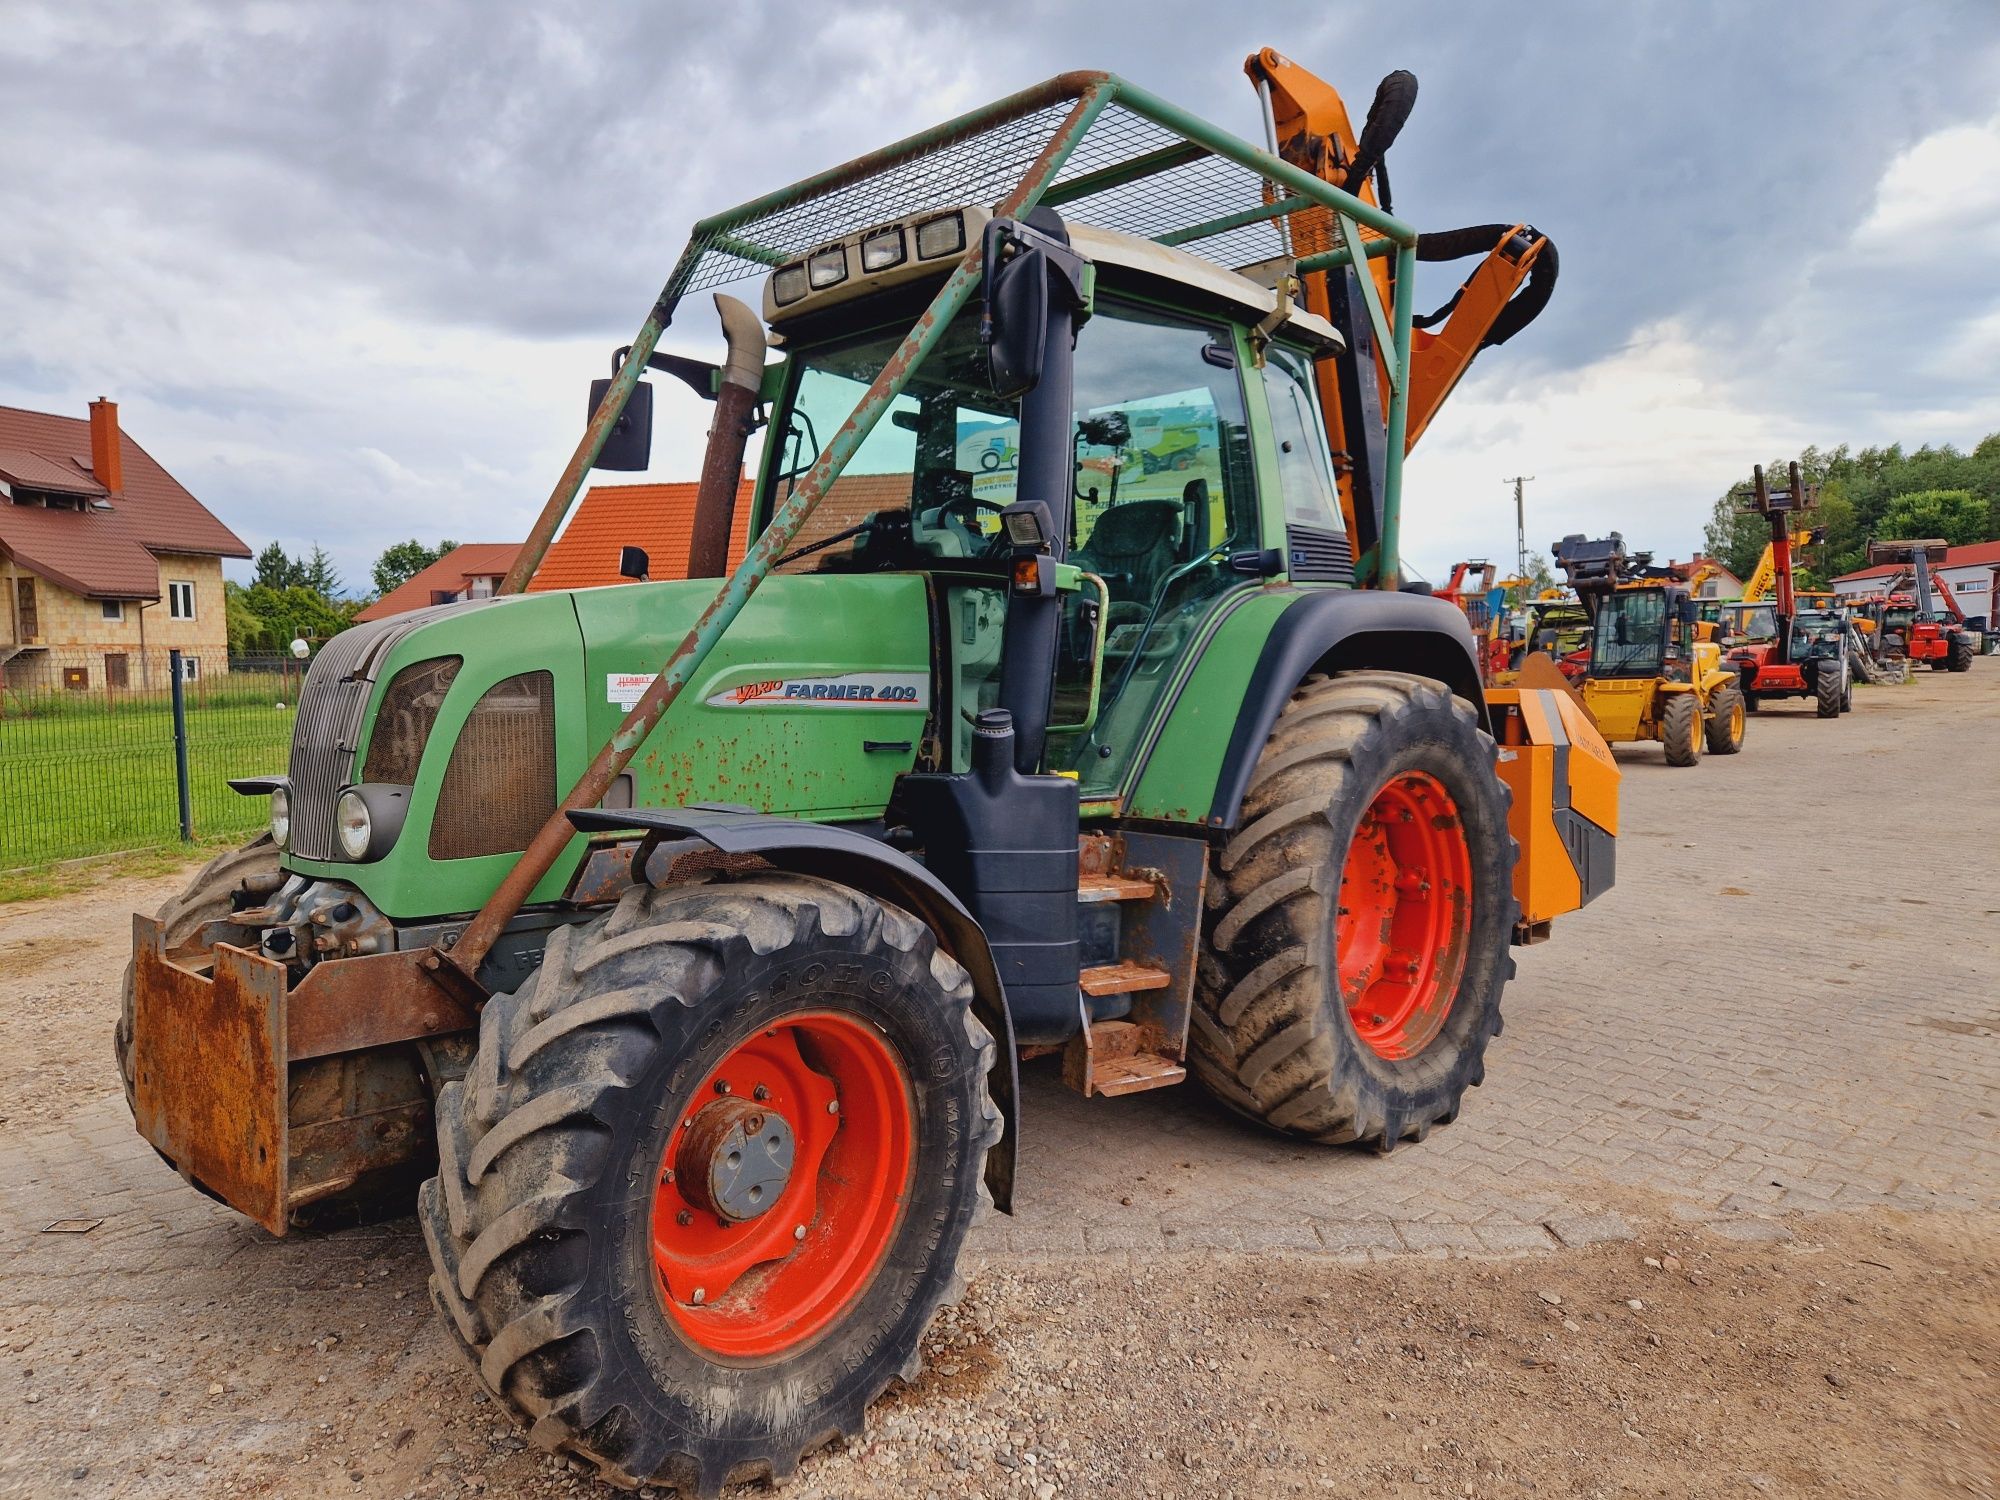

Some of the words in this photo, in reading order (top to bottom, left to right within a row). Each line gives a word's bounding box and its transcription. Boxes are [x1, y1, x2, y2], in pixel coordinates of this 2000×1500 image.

[735, 680, 783, 704] VARIO
[785, 684, 874, 700] FARMER
[877, 685, 917, 700] 409
[843, 1207, 950, 1375] TRACTION
